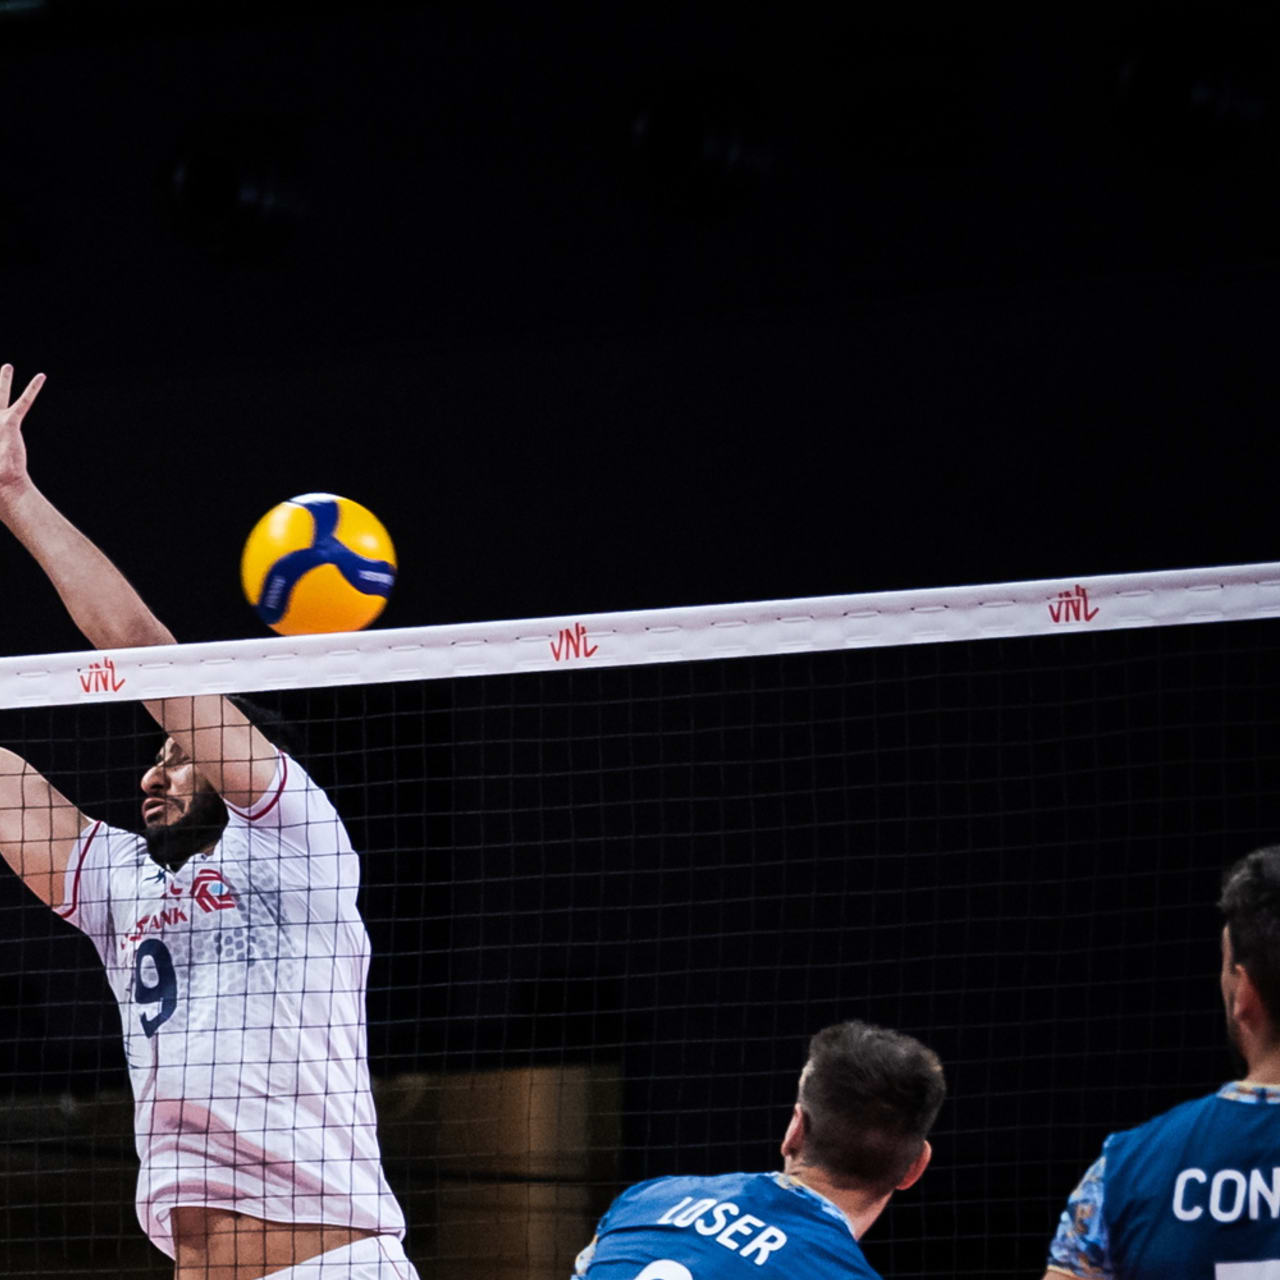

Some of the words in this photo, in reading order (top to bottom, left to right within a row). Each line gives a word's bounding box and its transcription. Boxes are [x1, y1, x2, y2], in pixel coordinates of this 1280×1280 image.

[1049, 584, 1099, 623] VNL
[550, 622, 598, 661] VNL
[80, 656, 125, 692] VNL
[135, 938, 178, 1039] 9
[1172, 1167, 1280, 1222] CON
[657, 1196, 788, 1266] LOSER
